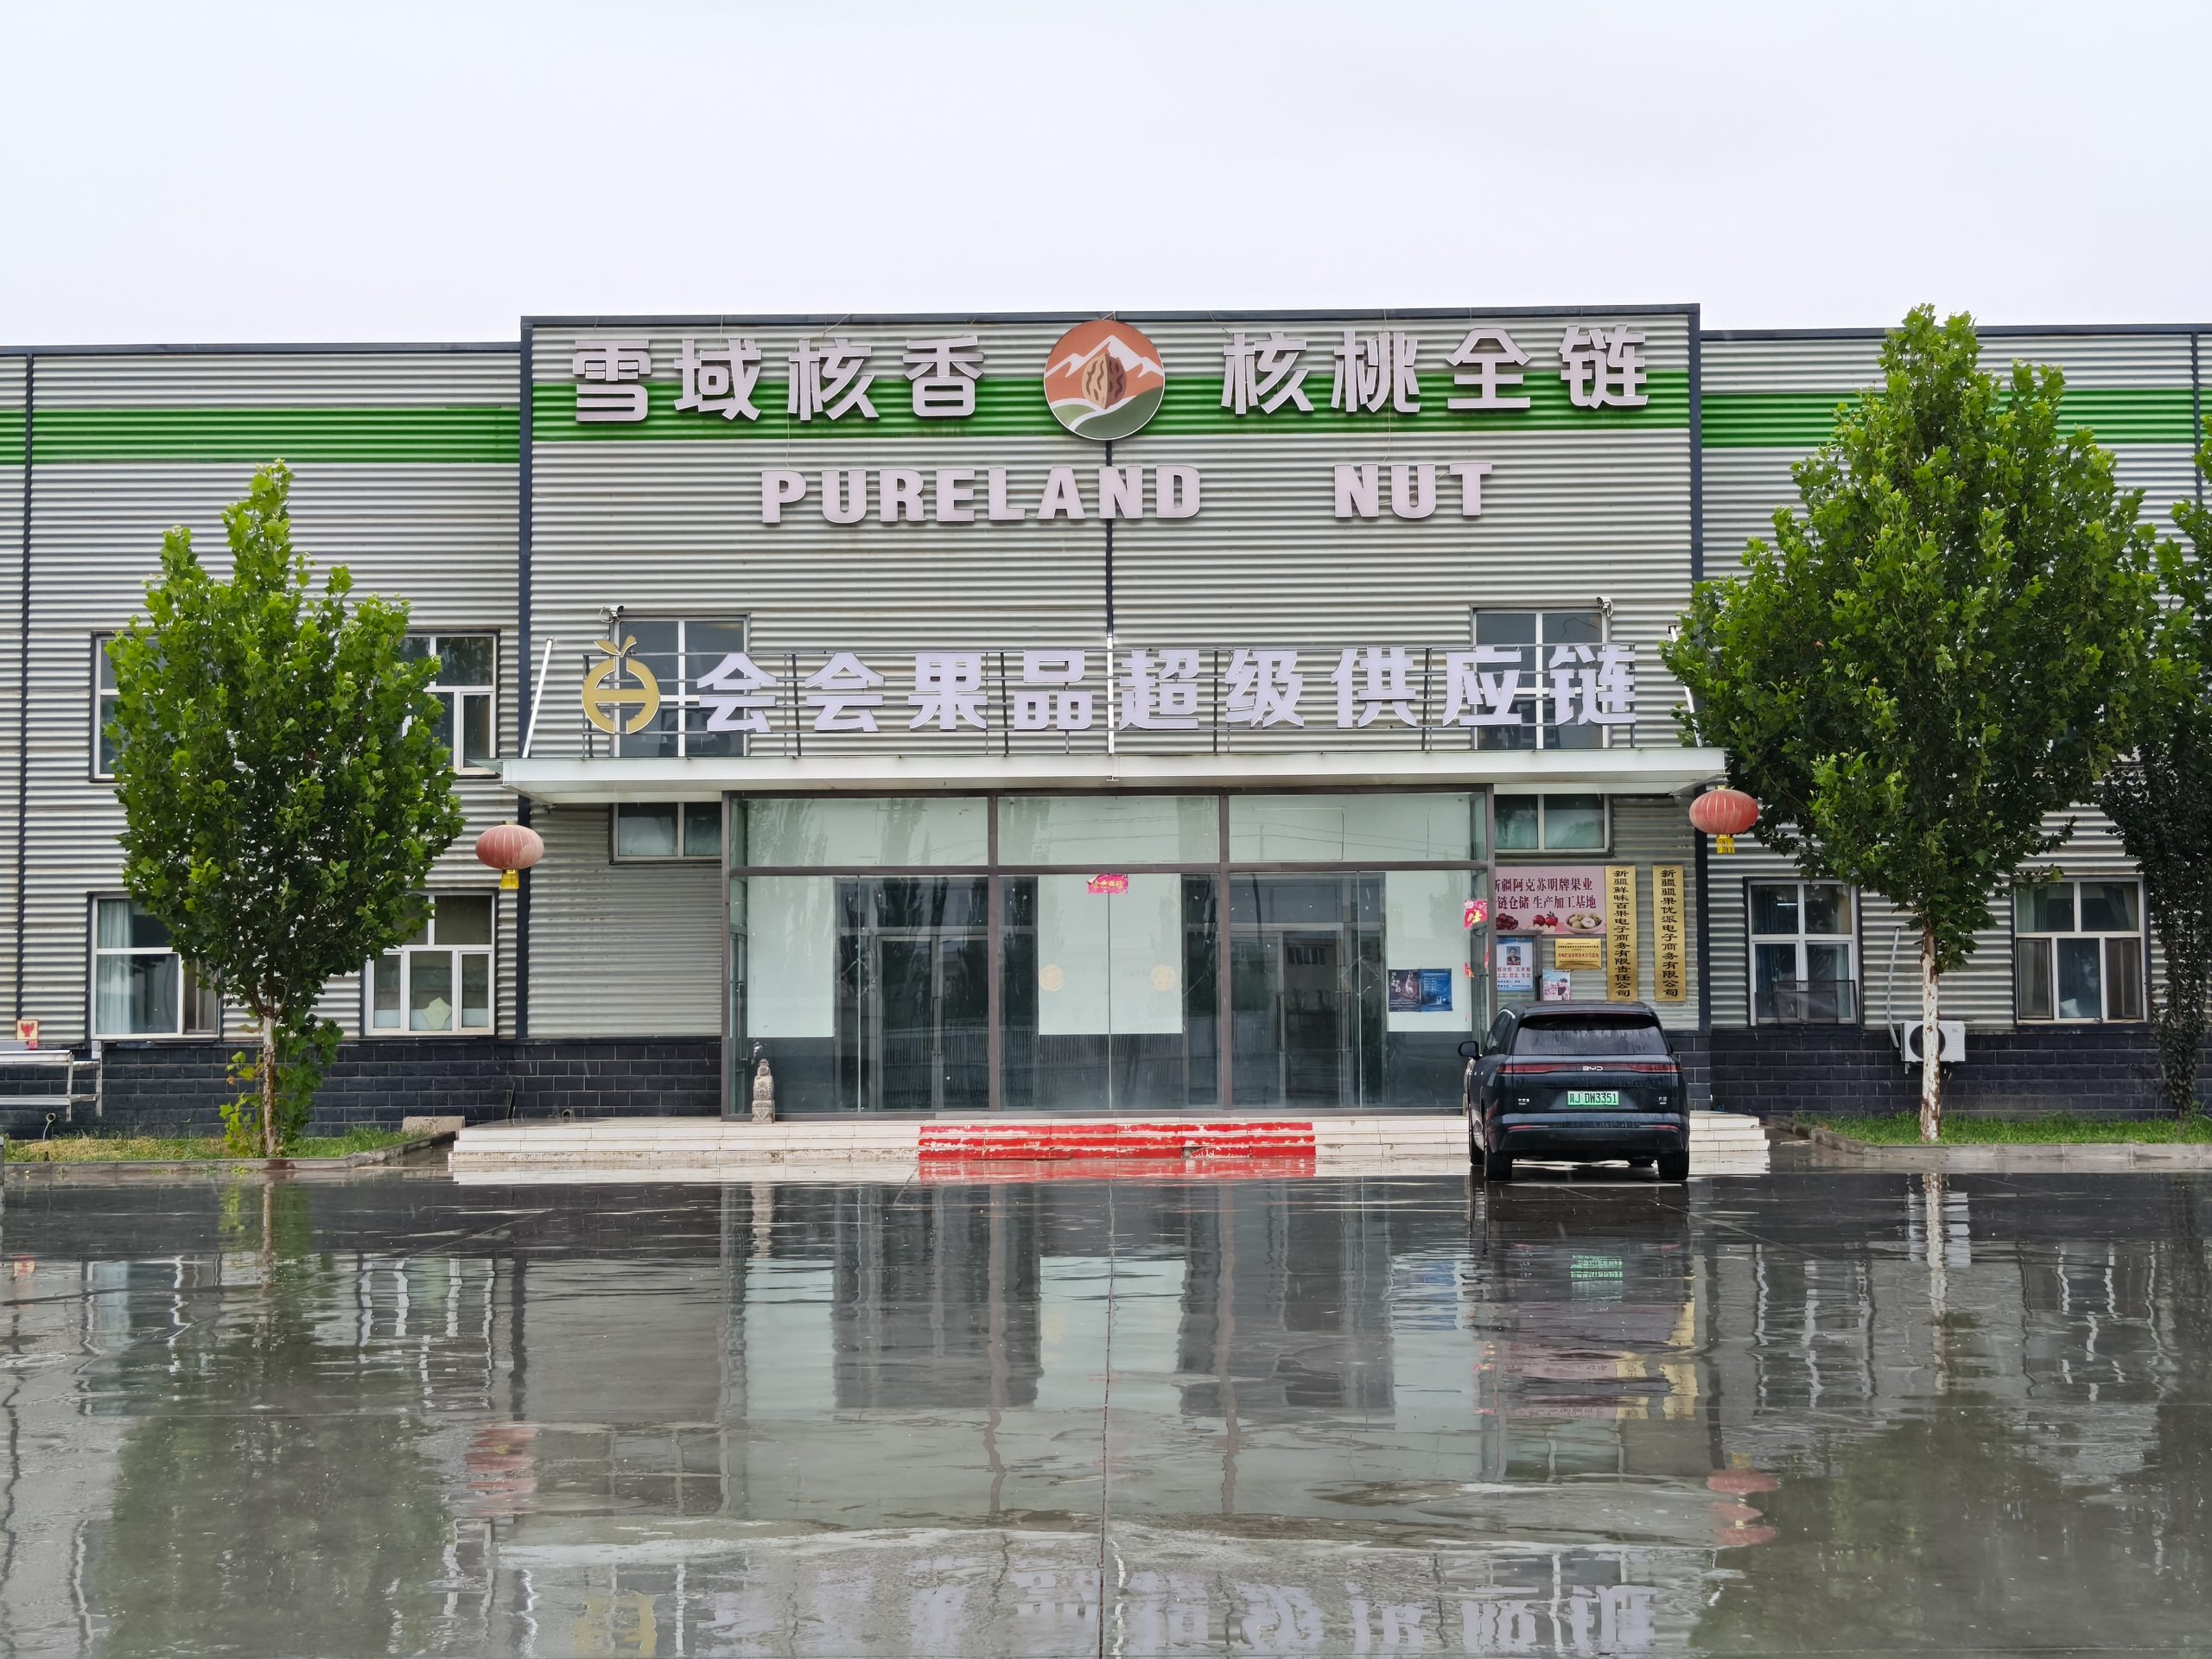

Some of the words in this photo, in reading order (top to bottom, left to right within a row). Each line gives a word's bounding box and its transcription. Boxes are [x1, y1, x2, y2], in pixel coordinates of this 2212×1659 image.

[572, 335, 984, 422] 雪域核香
[1220, 325, 1649, 415] 核桃全链
[761, 464, 1201, 524] PURELAND
[1333, 461, 1492, 519] NUT
[696, 644, 1637, 734] 会会果品超级供应链
[1495, 895, 1529, 909] 链仓储
[1533, 895, 1597, 909] 生产加工基地
[1585, 1092, 1617, 1103] DW3351
